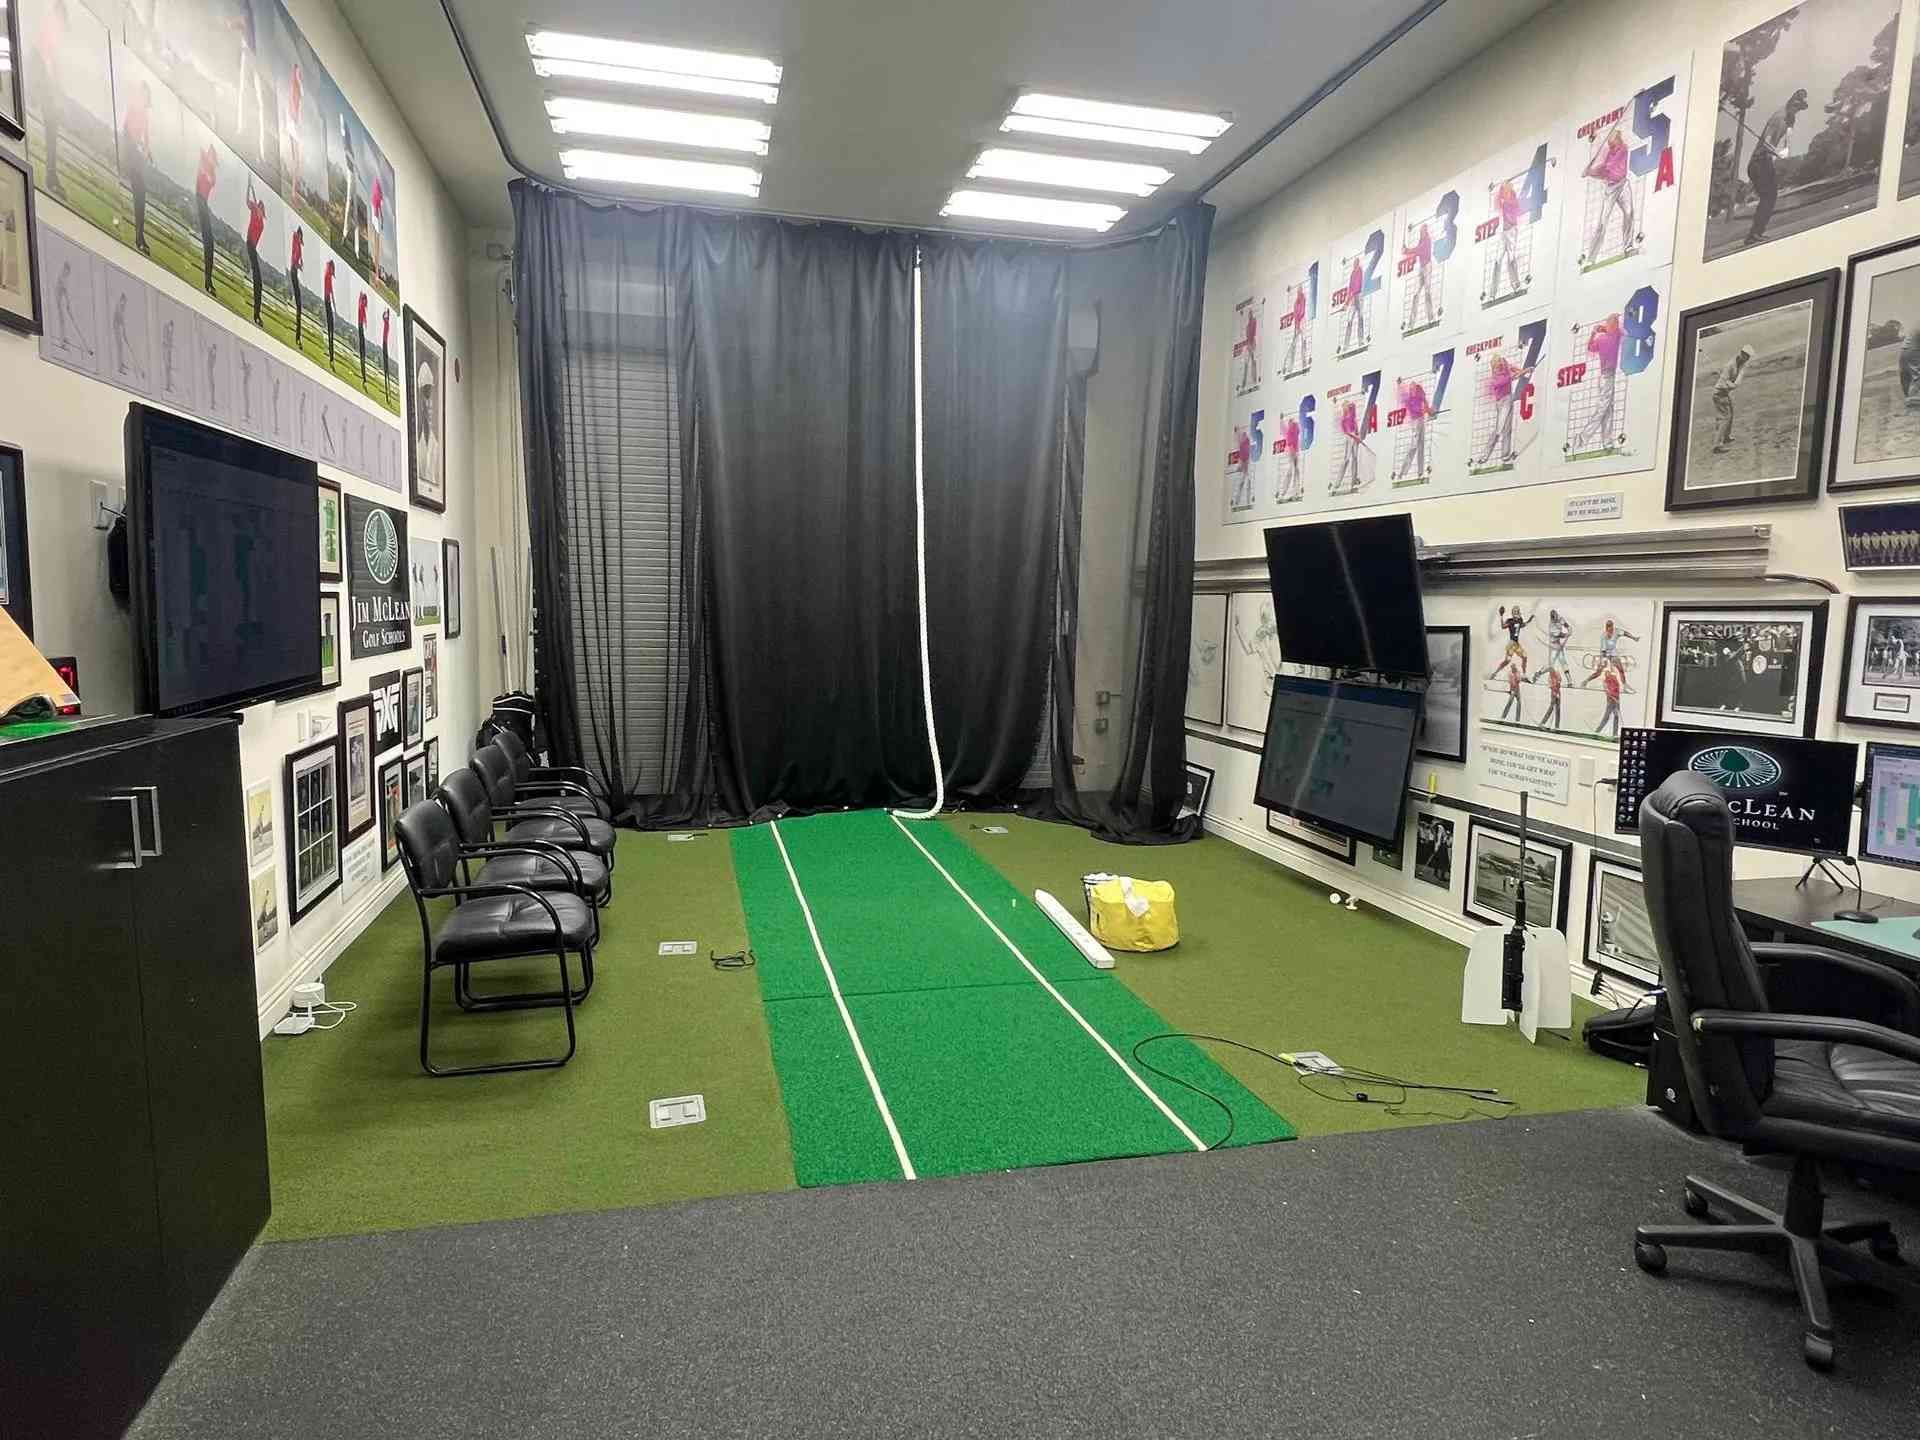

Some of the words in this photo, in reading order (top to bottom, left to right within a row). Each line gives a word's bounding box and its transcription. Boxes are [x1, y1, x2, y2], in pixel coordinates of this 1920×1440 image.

[1629, 75, 1675, 177] 5
[1654, 146, 1674, 192] A
[1475, 217, 1500, 243] STEP
[1518, 142, 1547, 225] 4
[1362, 229, 1384, 297] 2
[1397, 254, 1417, 277] STEP
[1433, 190, 1460, 264] 3
[1309, 261, 1319, 320] 1
[1511, 318, 1547, 401] 7
[1557, 363, 1586, 388] STEP
[1620, 285, 1659, 377] 8
[1361, 370, 1382, 441] 7
[1387, 408, 1407, 428] STEP
[1432, 348, 1456, 414] 7
[1520, 384, 1535, 420] C
[1250, 409, 1264, 463] 5
[1299, 394, 1317, 451] 6
[352, 596, 370, 631] JIM
[363, 630, 380, 648] GOLF
[381, 628, 406, 646] SCHOOLS
[1727, 798, 1816, 821] cLEAN
[1733, 817, 1780, 831] CHOOL
